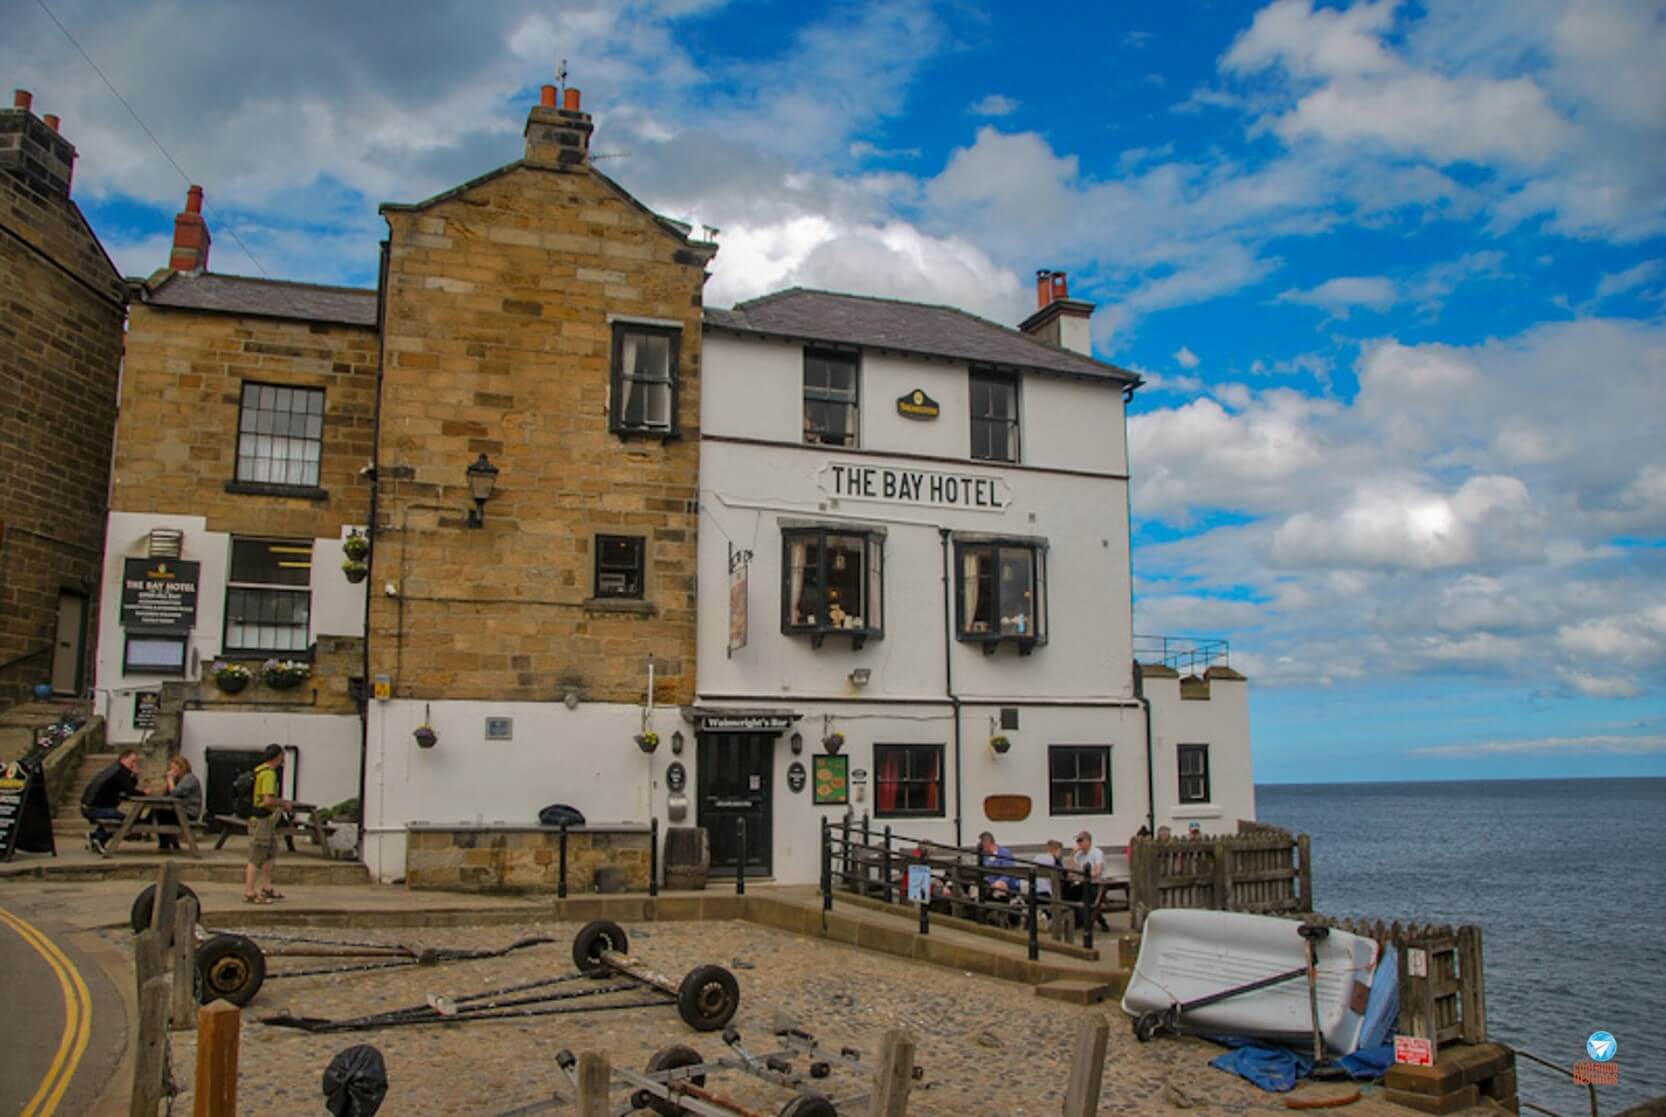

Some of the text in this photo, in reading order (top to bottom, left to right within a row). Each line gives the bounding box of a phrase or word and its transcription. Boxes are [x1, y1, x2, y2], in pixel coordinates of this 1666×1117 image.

[832, 466, 1003, 508] THE BAY HOTEL
[126, 580, 196, 593] THE BAY HOTEL
[770, 717, 788, 728] Bar
